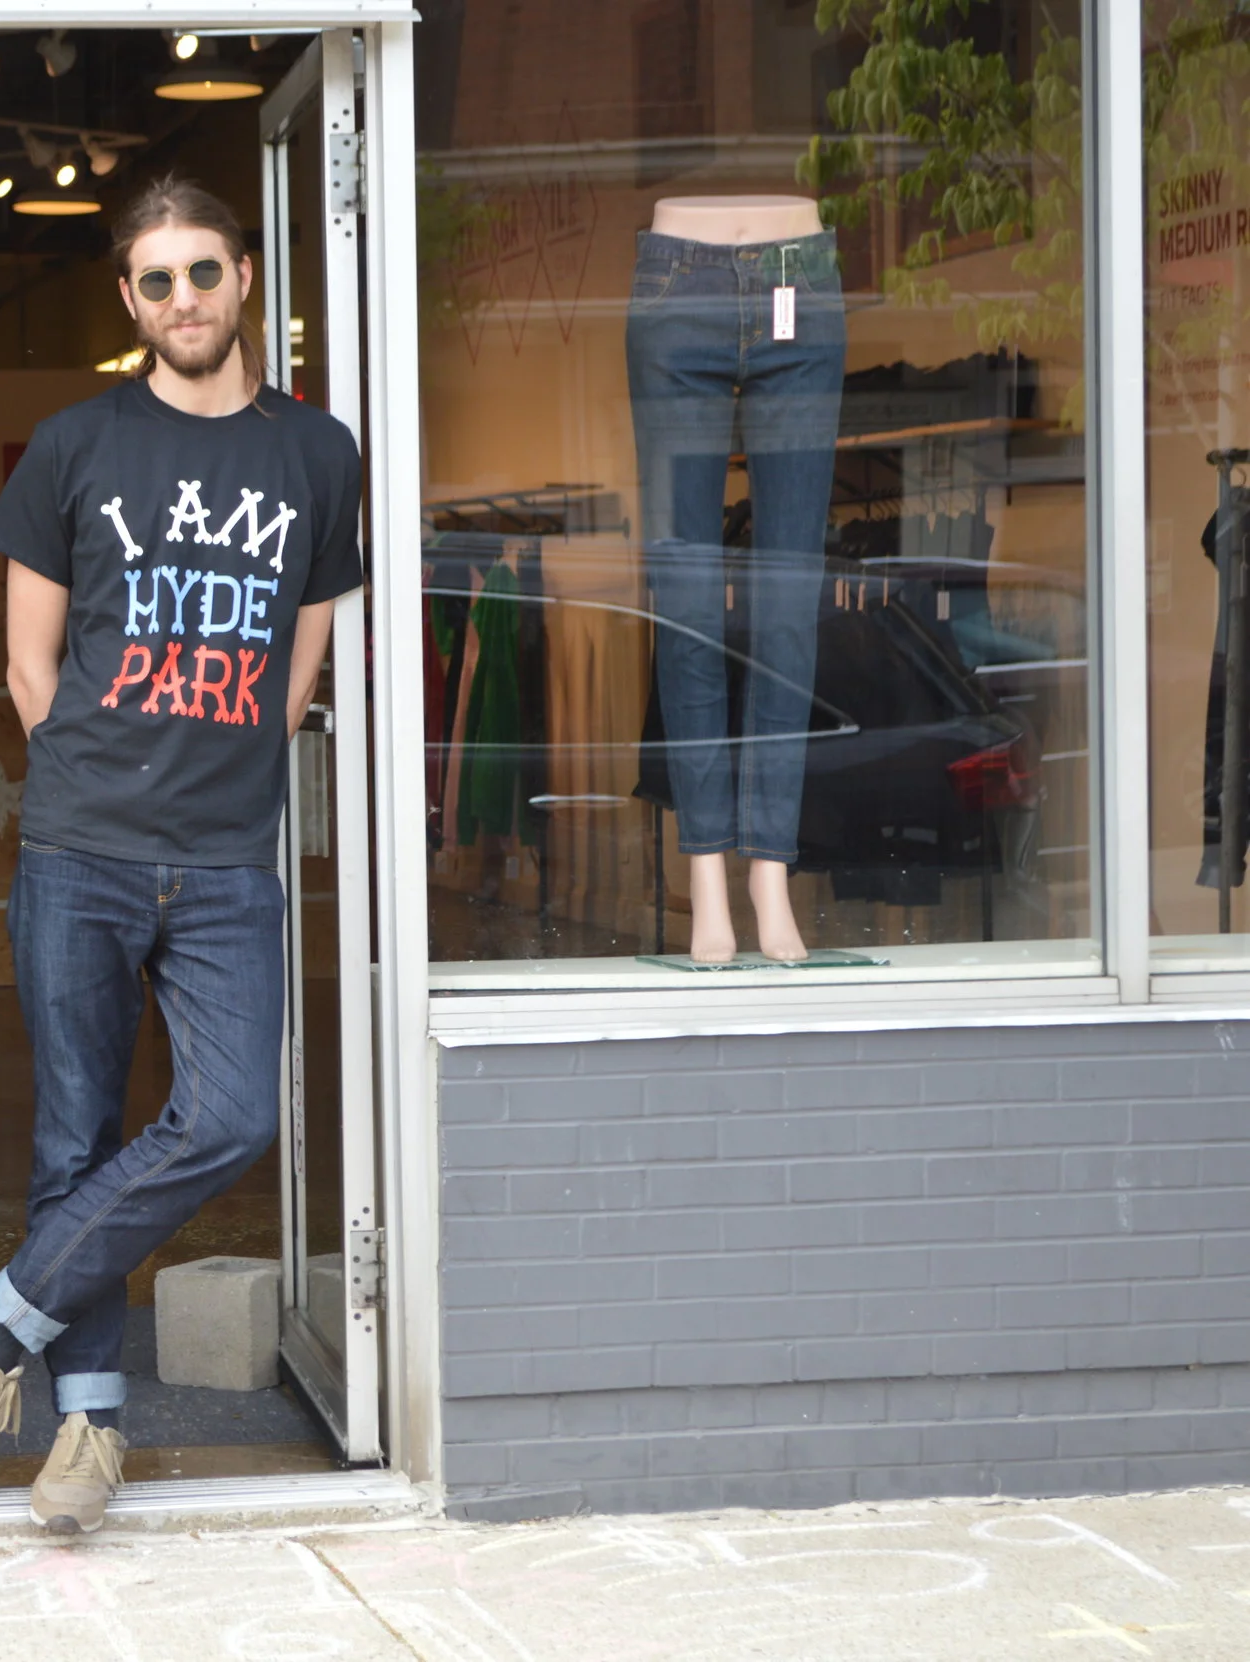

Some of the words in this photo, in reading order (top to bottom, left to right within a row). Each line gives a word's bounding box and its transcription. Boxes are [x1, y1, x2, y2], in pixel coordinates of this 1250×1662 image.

[1159, 166, 1224, 219] SKINNY
[1159, 211, 1231, 264] MEDIUM
[1237, 208, 1250, 247] R
[1181, 281, 1222, 306] FACTS
[100, 496, 144, 561] I
[166, 480, 298, 574] AM
[124, 565, 279, 646] HYDE
[101, 641, 269, 727] PARK
